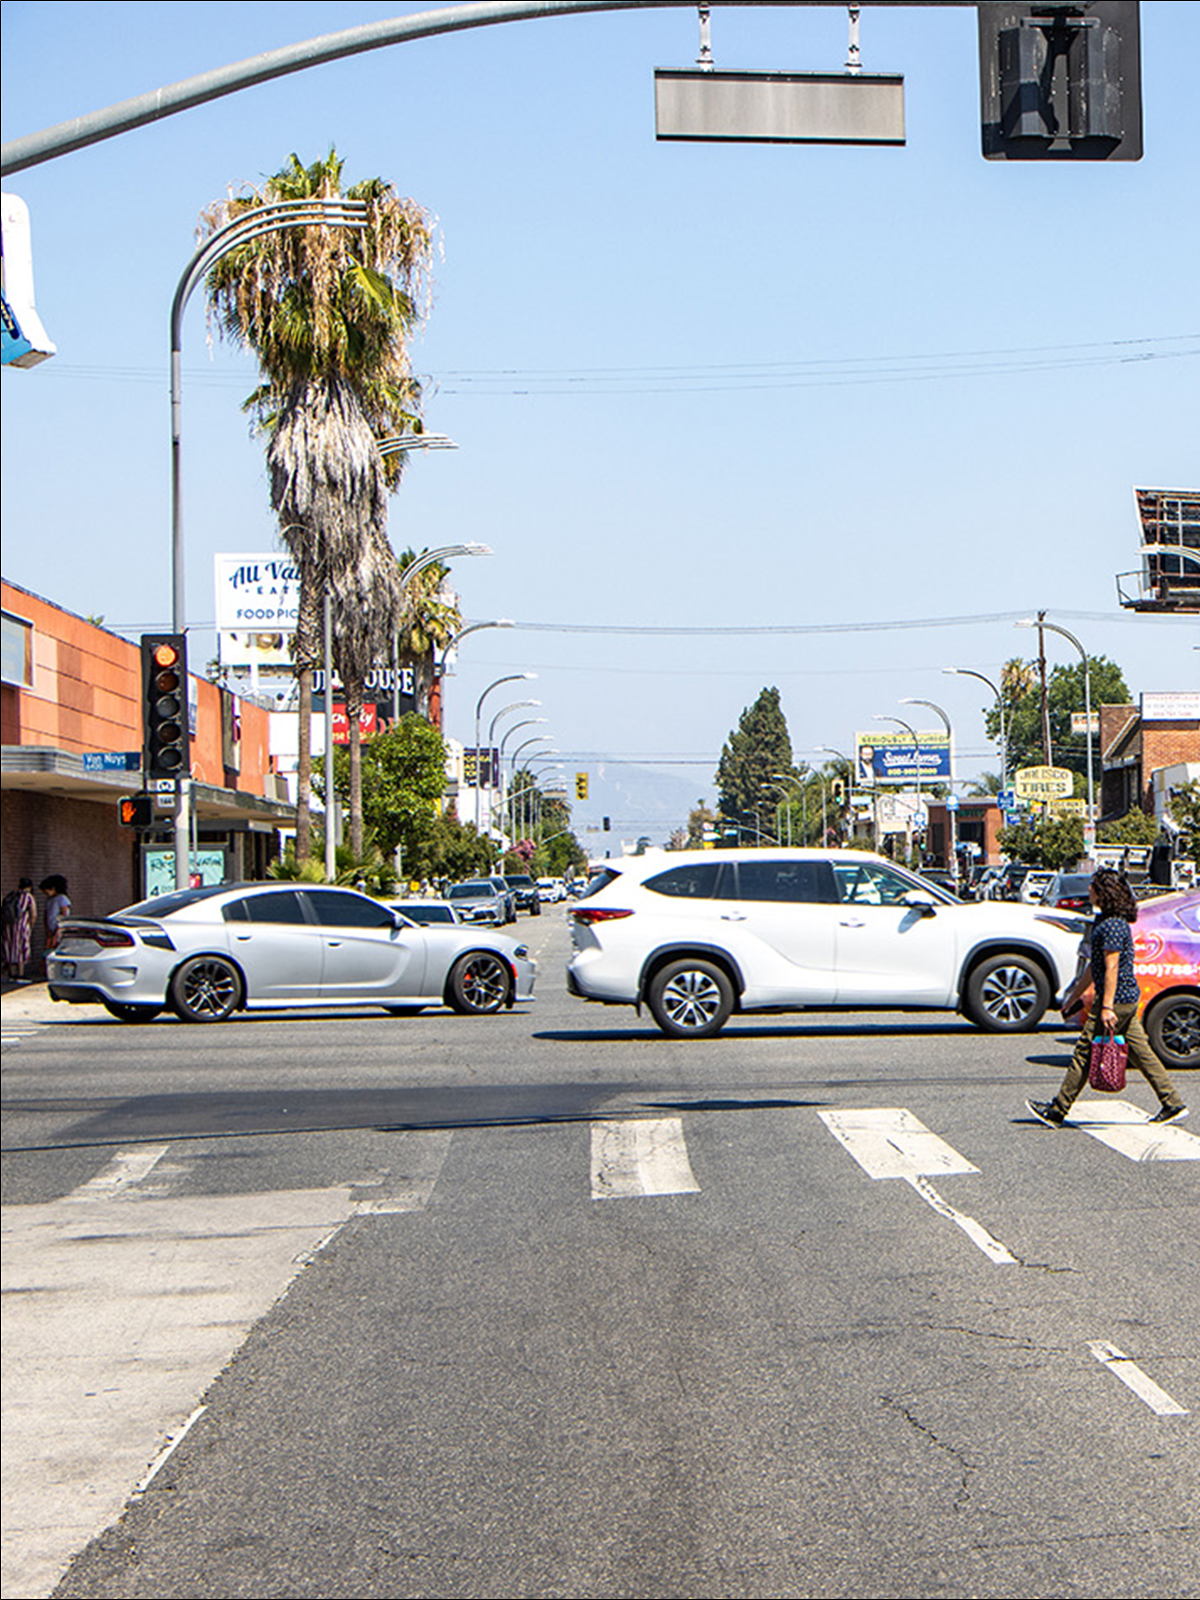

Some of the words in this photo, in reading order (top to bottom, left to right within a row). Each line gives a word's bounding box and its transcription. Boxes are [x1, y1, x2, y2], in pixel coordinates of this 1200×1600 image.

[228, 564, 261, 589] All
[264, 560, 301, 580] Val
[236, 608, 275, 620] FOOD
[277, 607, 300, 619] PIC
[1020, 782, 1067, 793] TIRES
